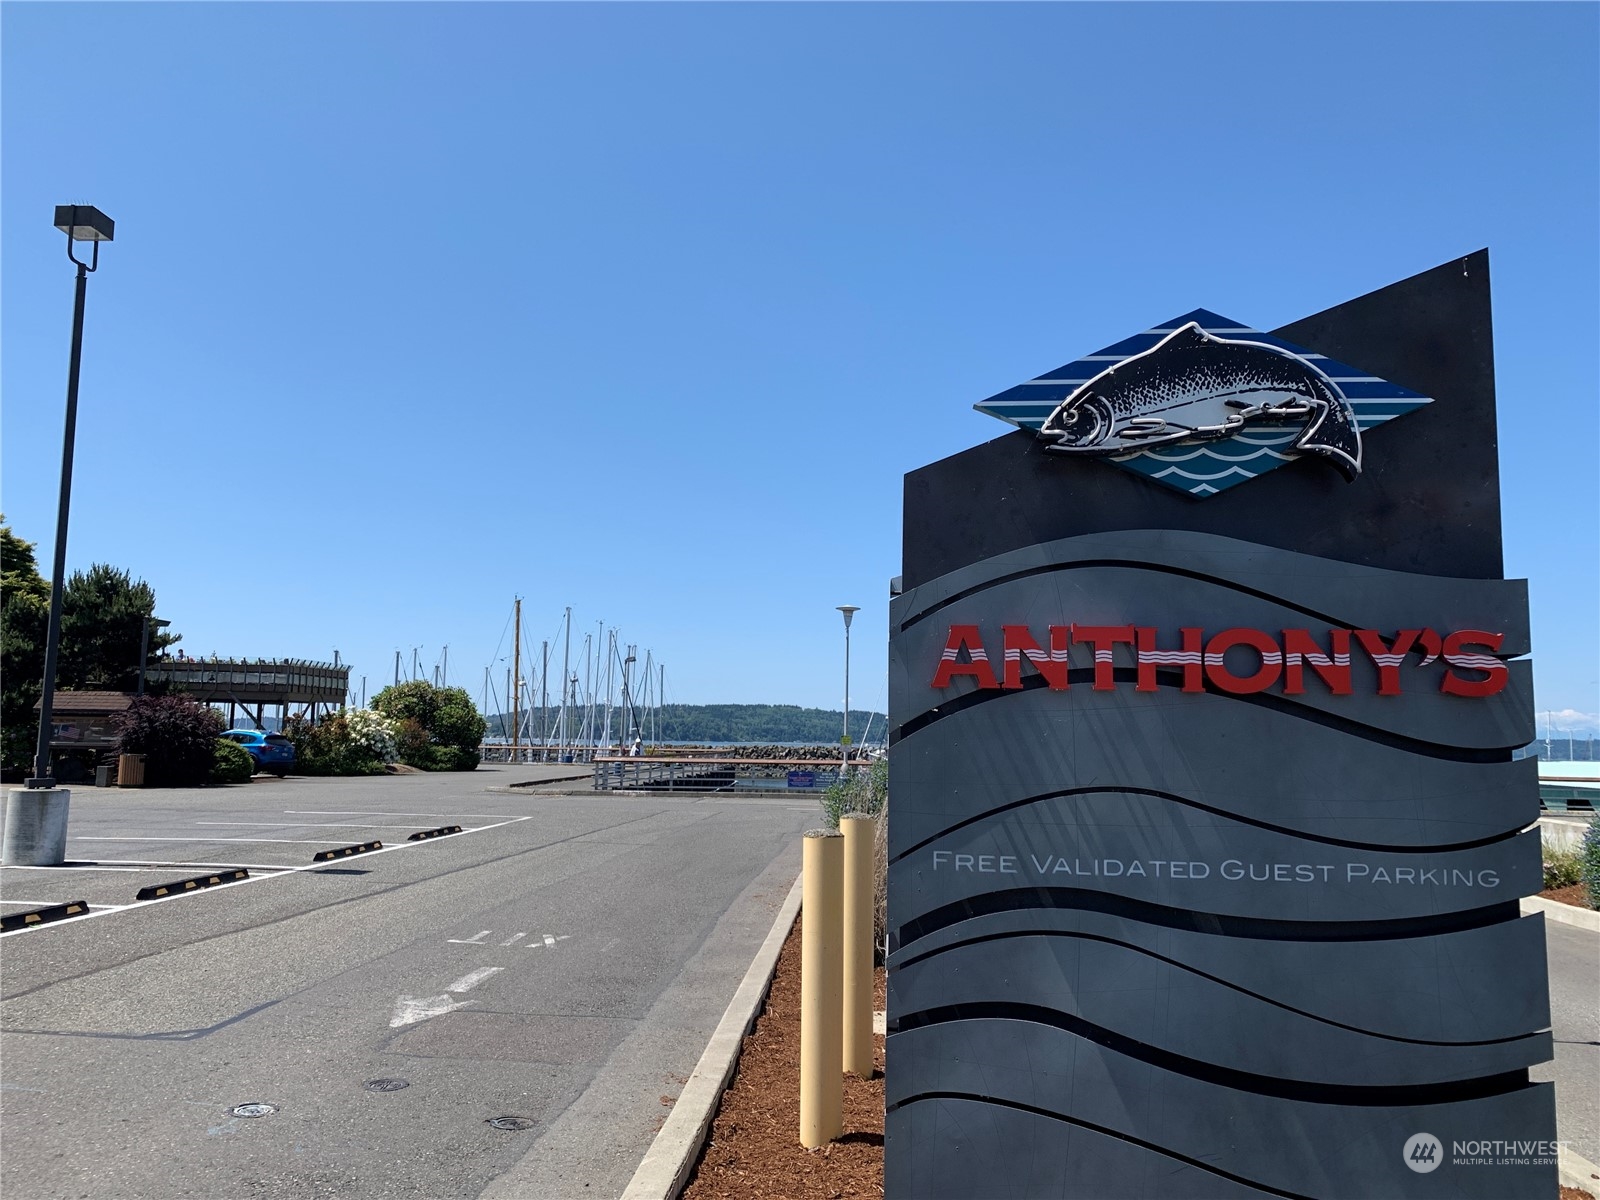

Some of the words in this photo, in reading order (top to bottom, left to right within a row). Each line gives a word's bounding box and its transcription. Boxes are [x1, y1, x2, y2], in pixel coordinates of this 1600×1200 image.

[931, 624, 1509, 697] ANTHONY'S
[933, 851, 1017, 873] FREE
[1031, 854, 1210, 879] VALIDATED
[1220, 860, 1335, 883] GUEST
[1347, 863, 1500, 888] PARKING
